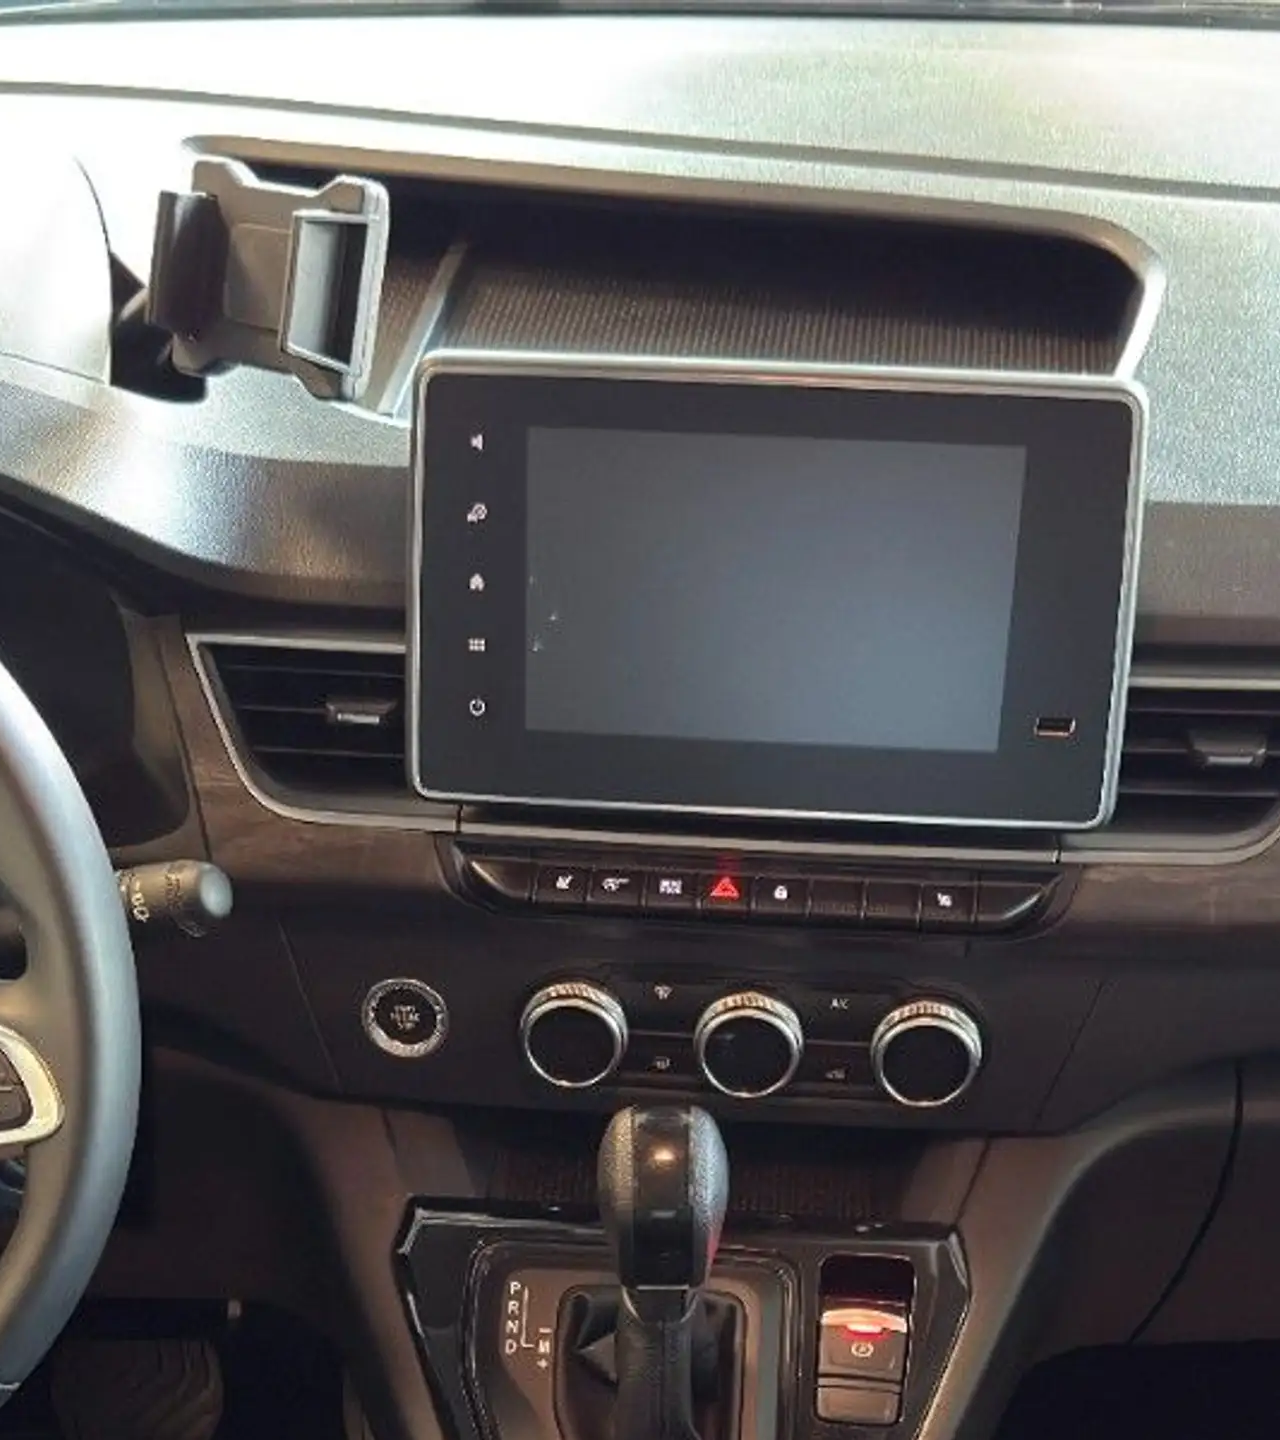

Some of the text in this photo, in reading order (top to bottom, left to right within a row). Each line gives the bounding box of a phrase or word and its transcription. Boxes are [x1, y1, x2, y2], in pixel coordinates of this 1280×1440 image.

[509, 1281, 522, 1295] P
[507, 1301, 520, 1315] R
[505, 1320, 519, 1334] N
[504, 1339, 517, 1355] D
